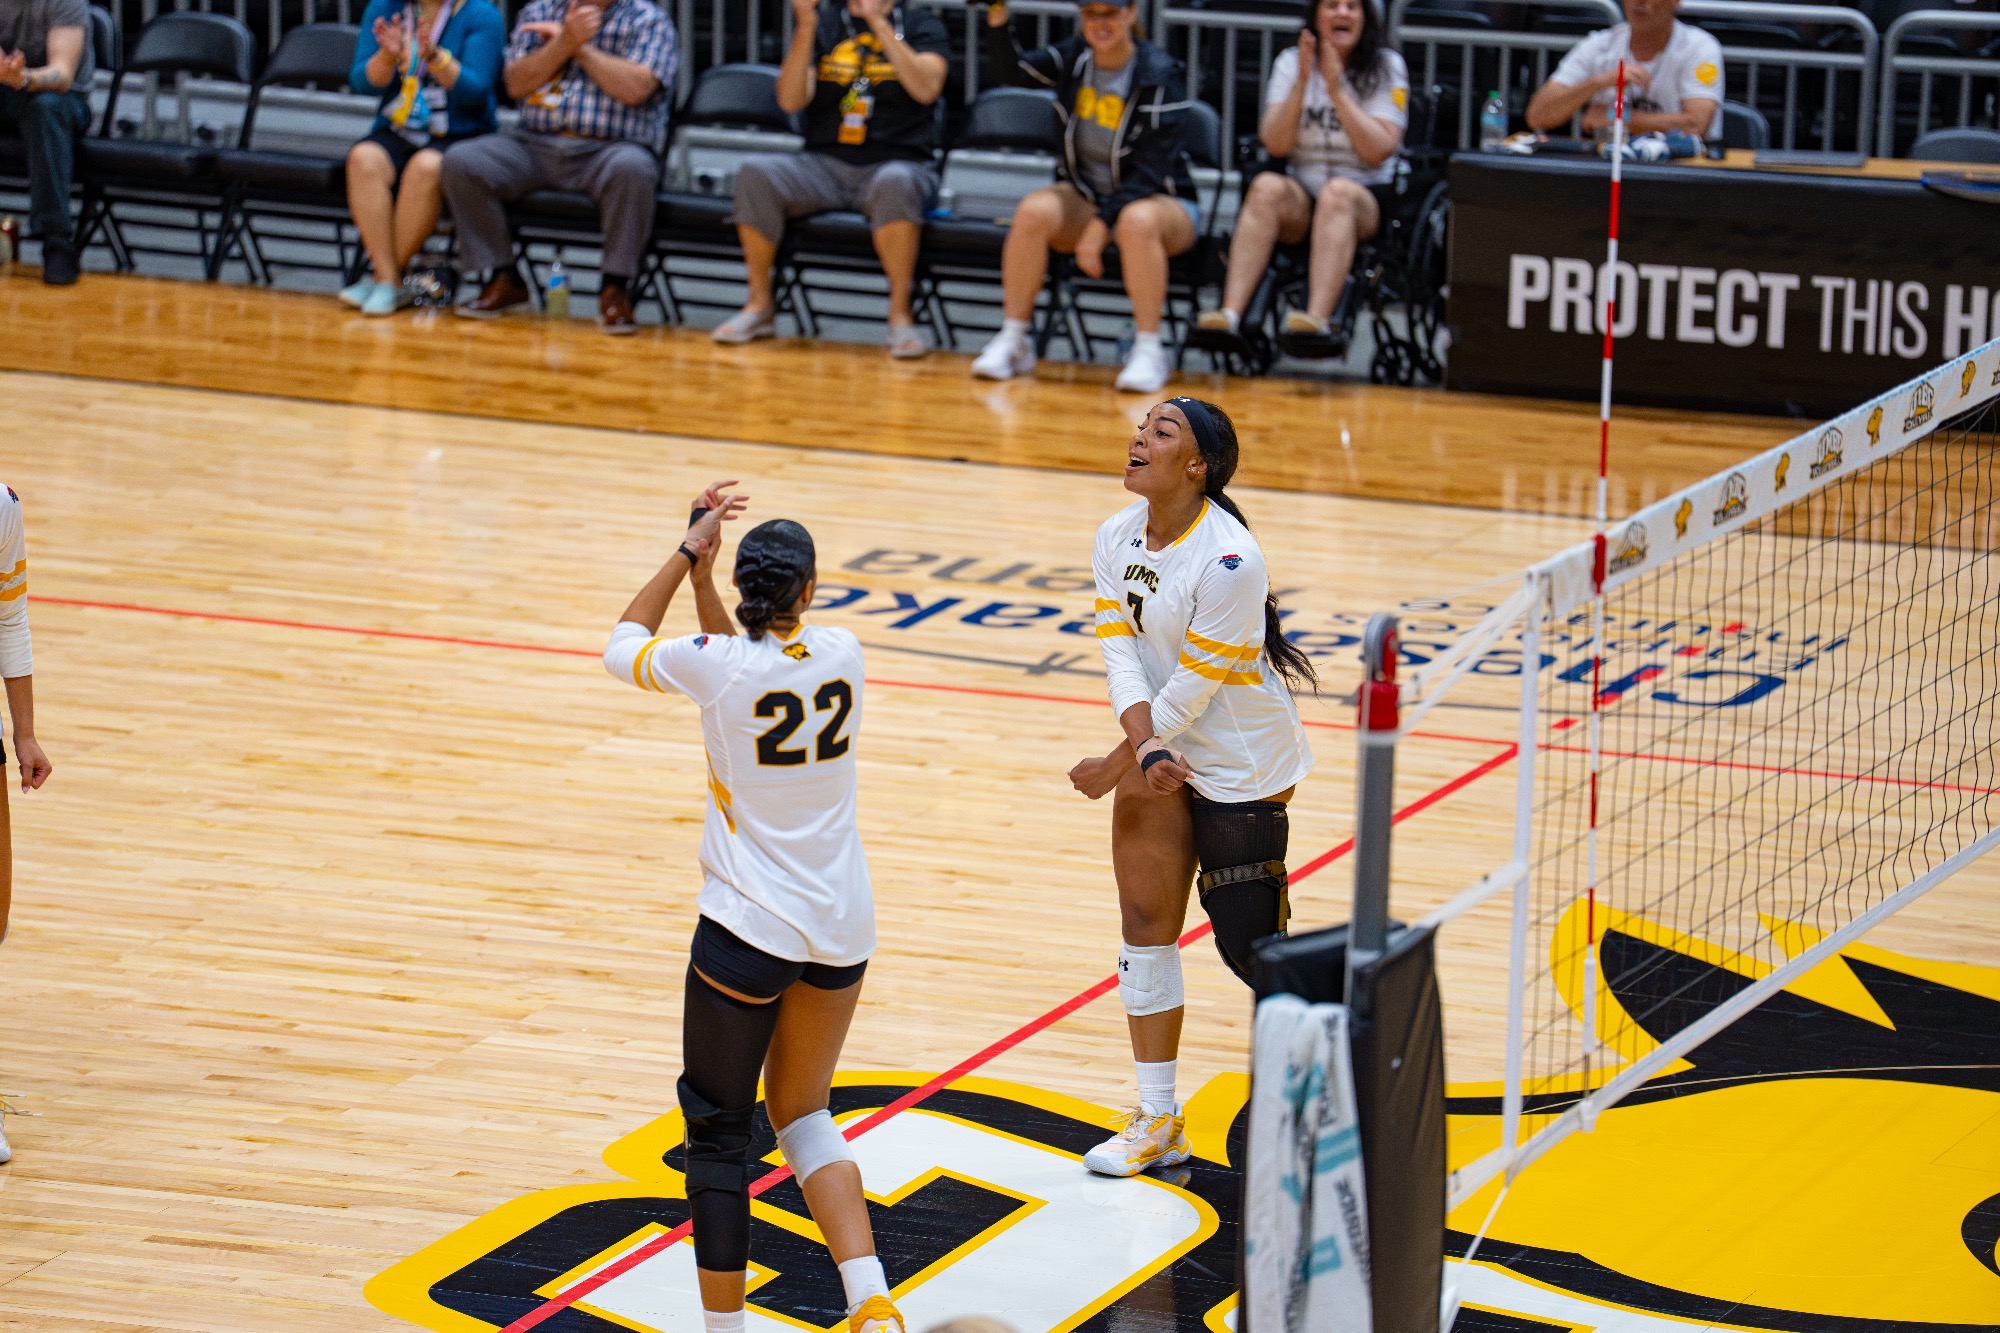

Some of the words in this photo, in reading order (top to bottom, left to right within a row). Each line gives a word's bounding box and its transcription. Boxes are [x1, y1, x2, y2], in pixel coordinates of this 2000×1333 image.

[1507, 253, 1800, 349] PROTECT
[1811, 275, 1930, 360] THIS
[1942, 283, 2000, 360] H
[808, 583, 1787, 707] Chesaake
[1126, 589, 1146, 635] 7
[1400, 600, 1848, 653] Insurace
[754, 677, 853, 767] 22
